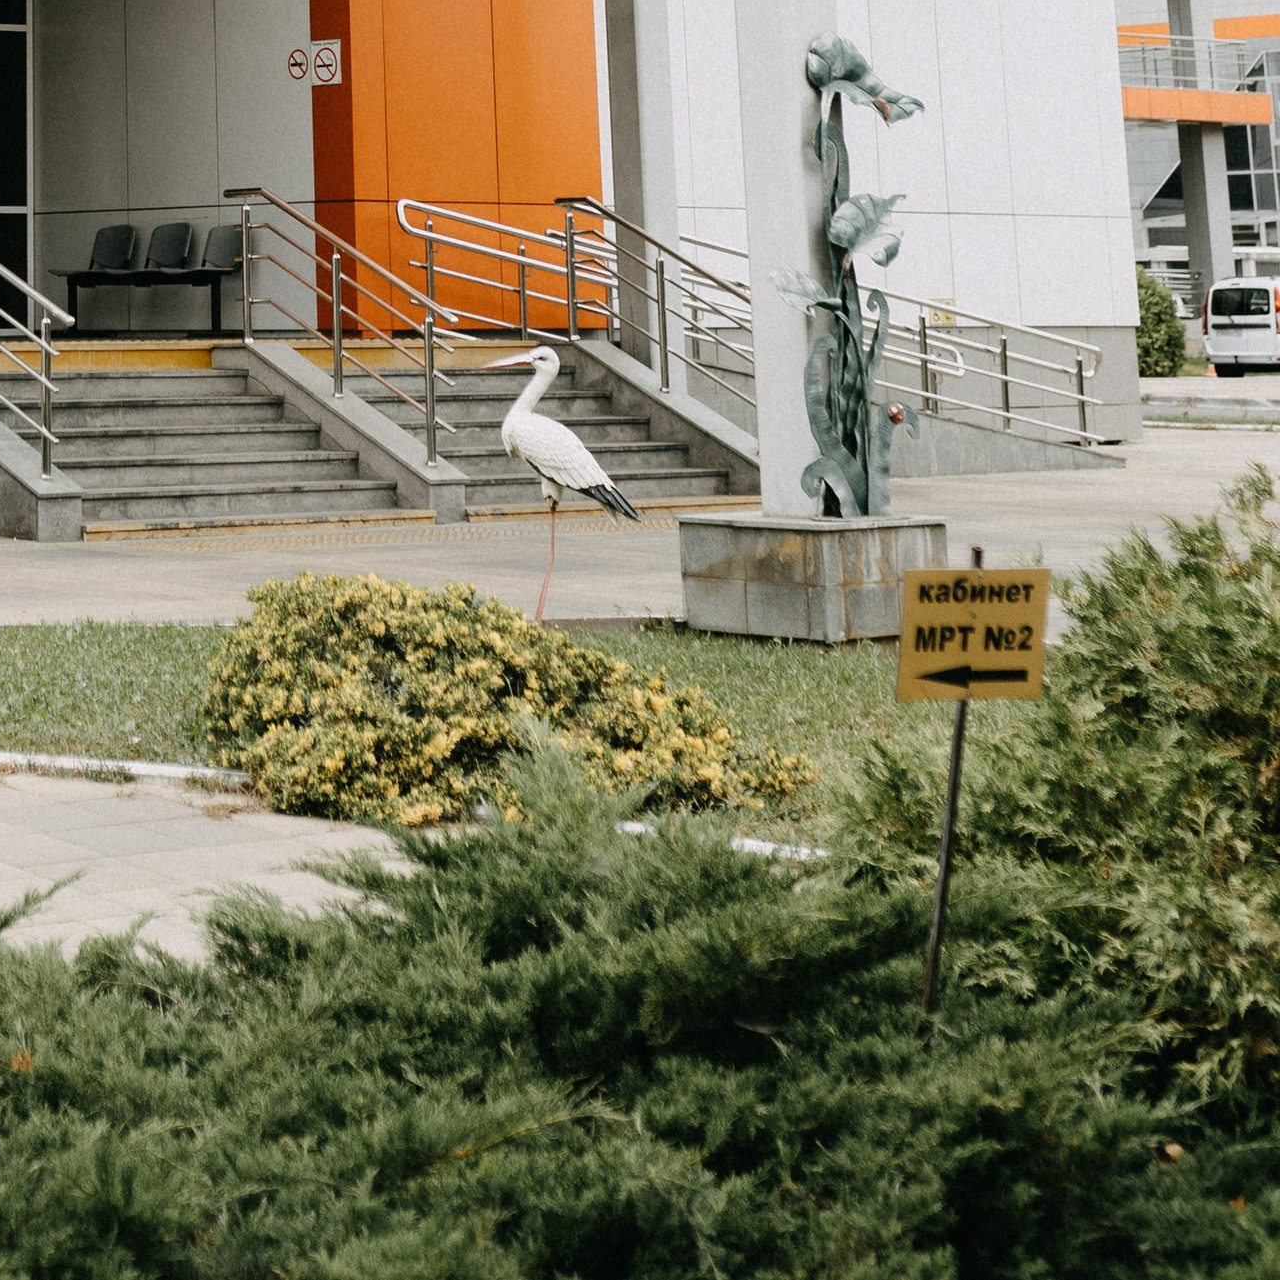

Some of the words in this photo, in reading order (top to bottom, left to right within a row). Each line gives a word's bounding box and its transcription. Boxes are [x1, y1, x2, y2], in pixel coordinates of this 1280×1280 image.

[918, 577, 1035, 604] кабинет
[915, 625, 976, 653] МРТ
[983, 625, 1034, 653] №2
